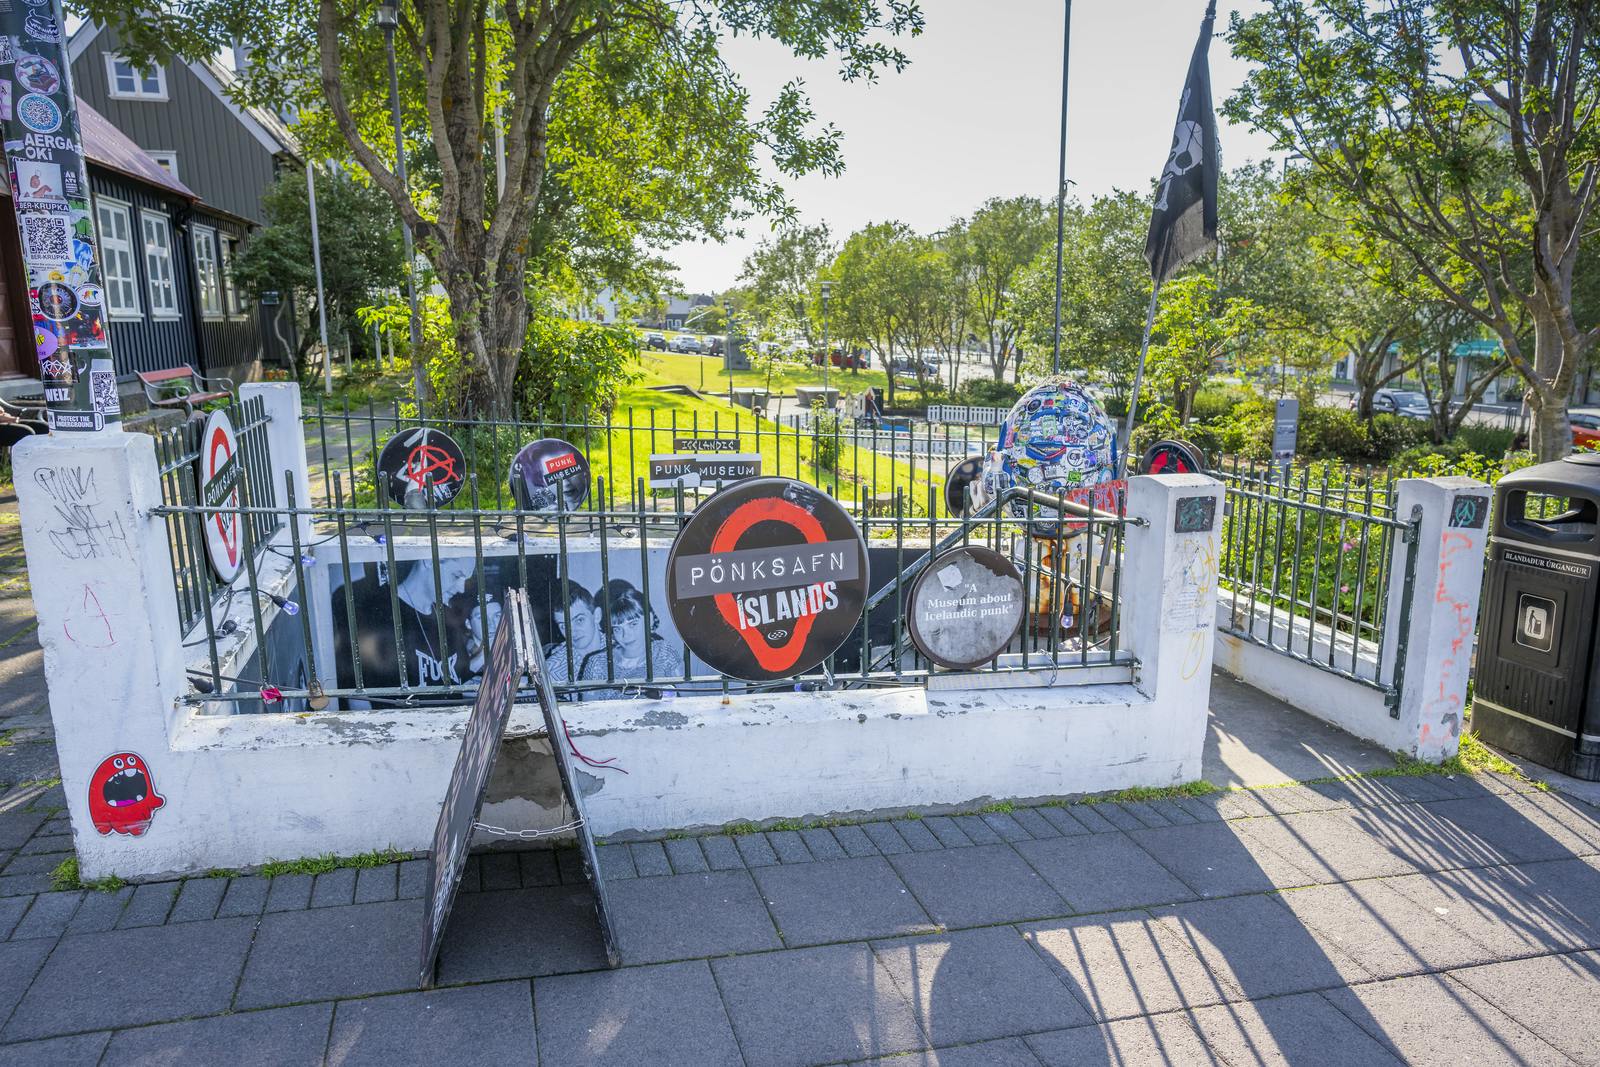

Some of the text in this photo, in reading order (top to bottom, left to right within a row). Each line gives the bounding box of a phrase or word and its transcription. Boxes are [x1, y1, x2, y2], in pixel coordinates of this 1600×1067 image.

[24, 132, 75, 152] AERGA
[549, 457, 572, 469] PUNK
[655, 464, 754, 476] PUNK MUSEUM
[547, 464, 581, 483] MUSEUM
[691, 552, 844, 586] PÖNKSAFN
[964, 583, 978, 593] "A
[736, 580, 839, 630] ÍSLANDS
[927, 593, 1013, 609] Museum about
[925, 604, 1014, 621] Icelandic punk"
